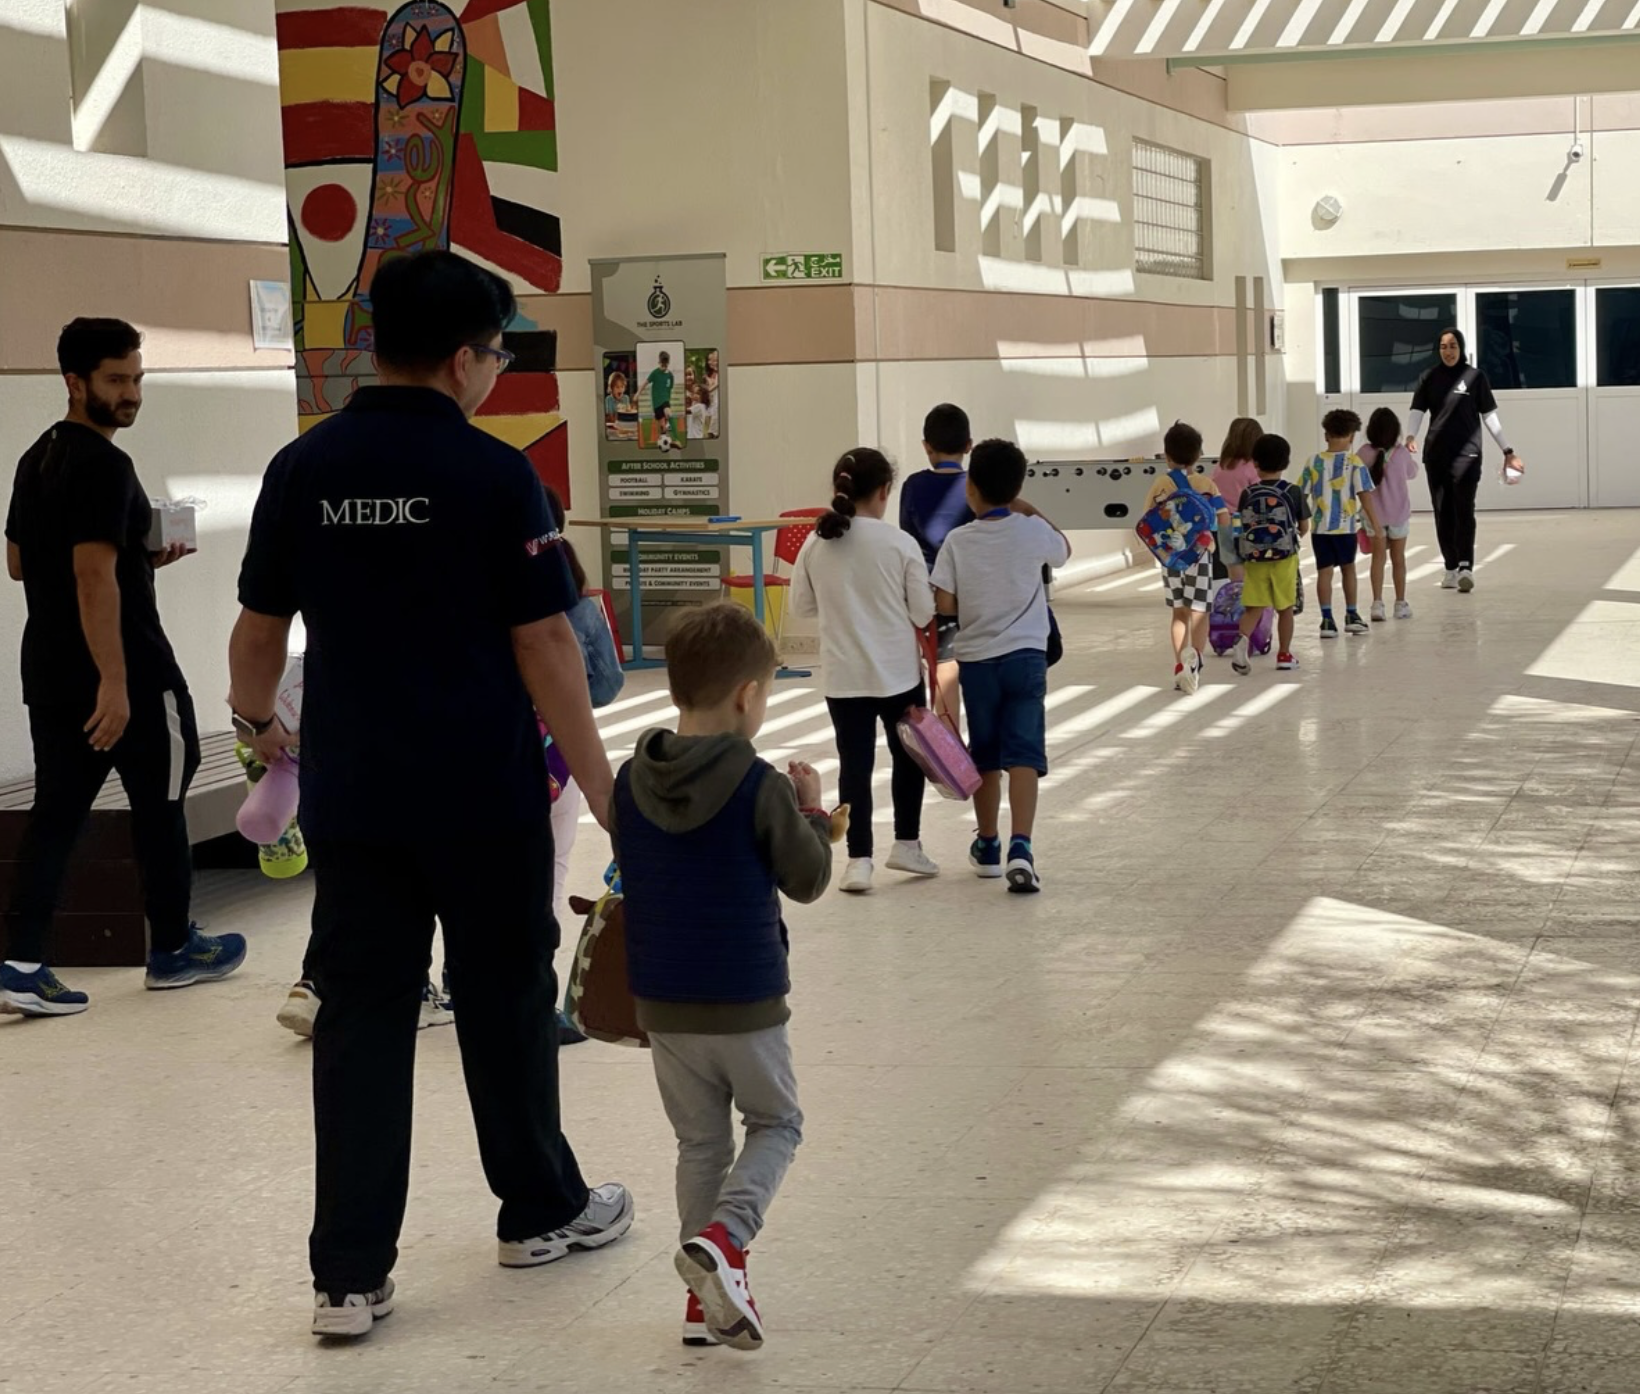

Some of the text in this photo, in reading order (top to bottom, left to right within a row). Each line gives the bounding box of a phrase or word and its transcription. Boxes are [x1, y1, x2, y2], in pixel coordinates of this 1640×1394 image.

[811, 267, 841, 277] EXIT
[621, 461, 705, 470] AFTER SCHOOL ACTIVITIES
[320, 497, 430, 526] MEDIC
[637, 507, 690, 516] HOLIDAY CAMPS
